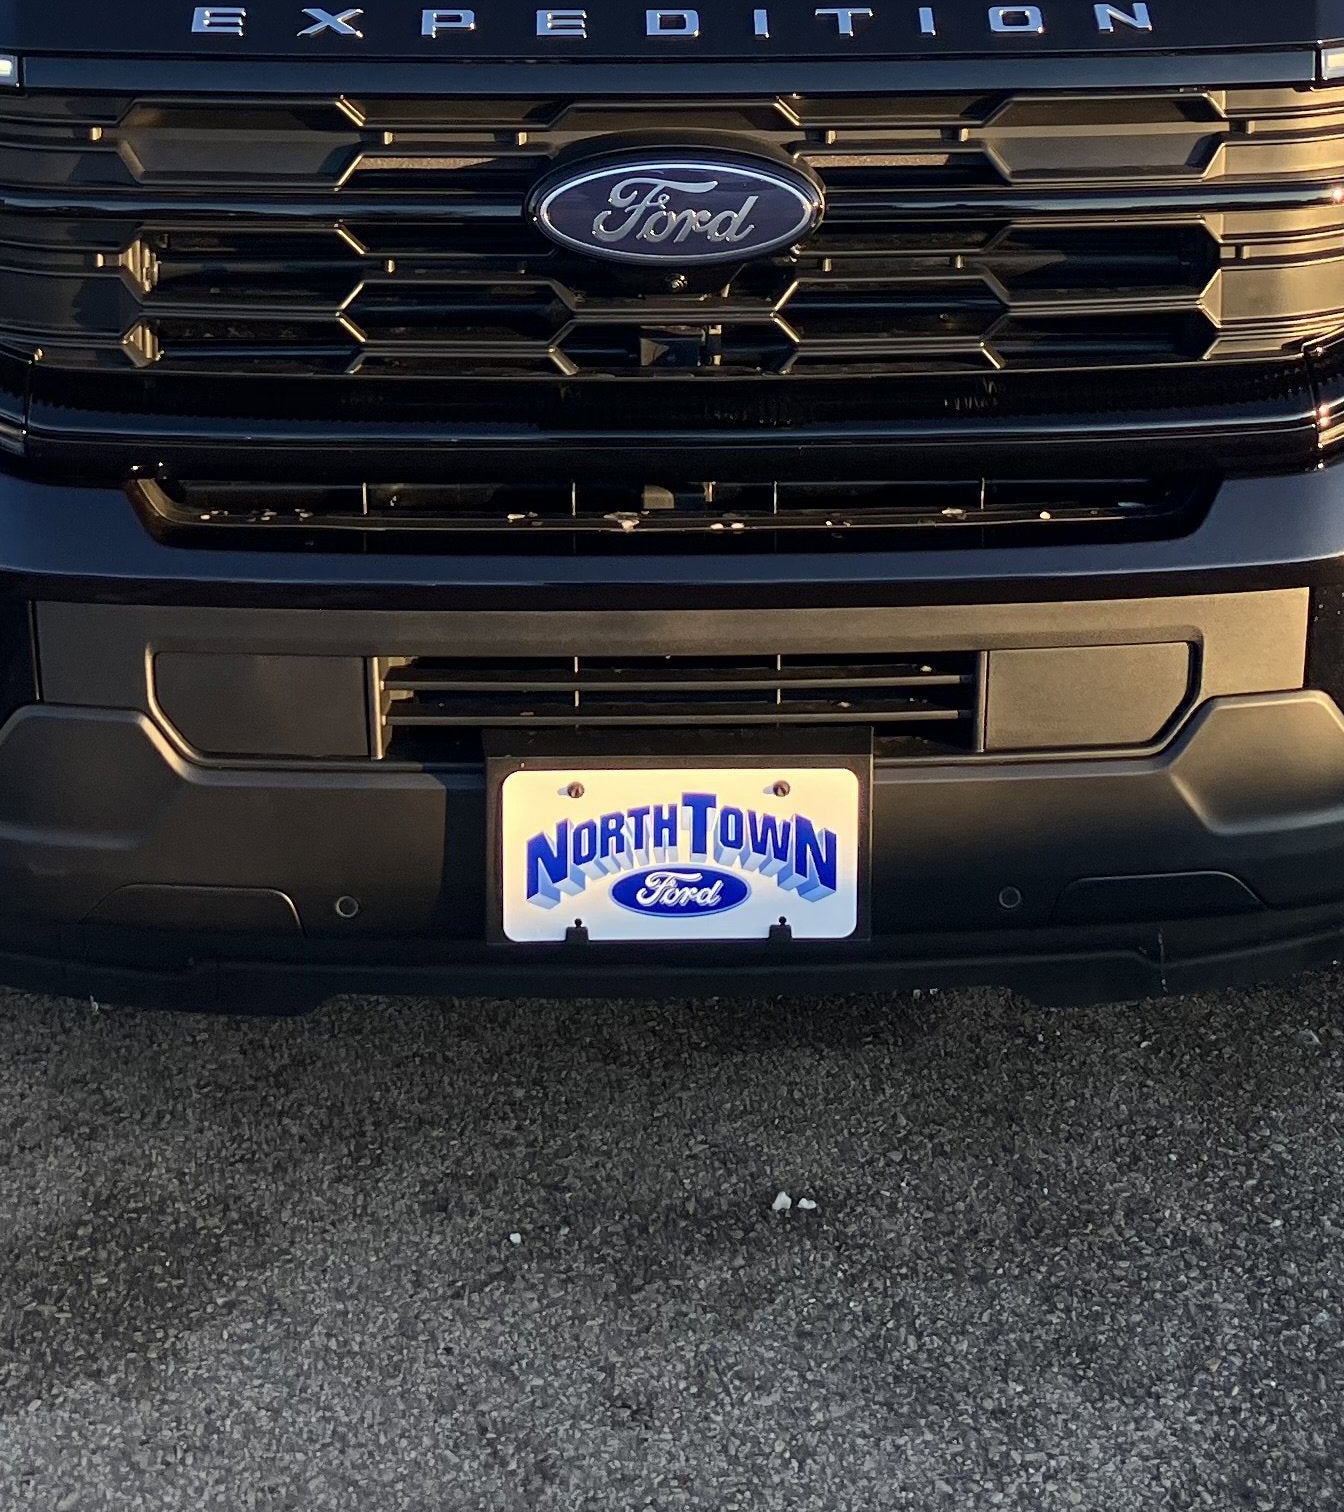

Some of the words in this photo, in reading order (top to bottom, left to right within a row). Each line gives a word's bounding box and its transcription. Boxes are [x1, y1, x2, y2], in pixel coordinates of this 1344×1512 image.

[191, 1, 1153, 37] EXPEDITION
[592, 177, 759, 244] Ford
[636, 871, 724, 907] Ford
